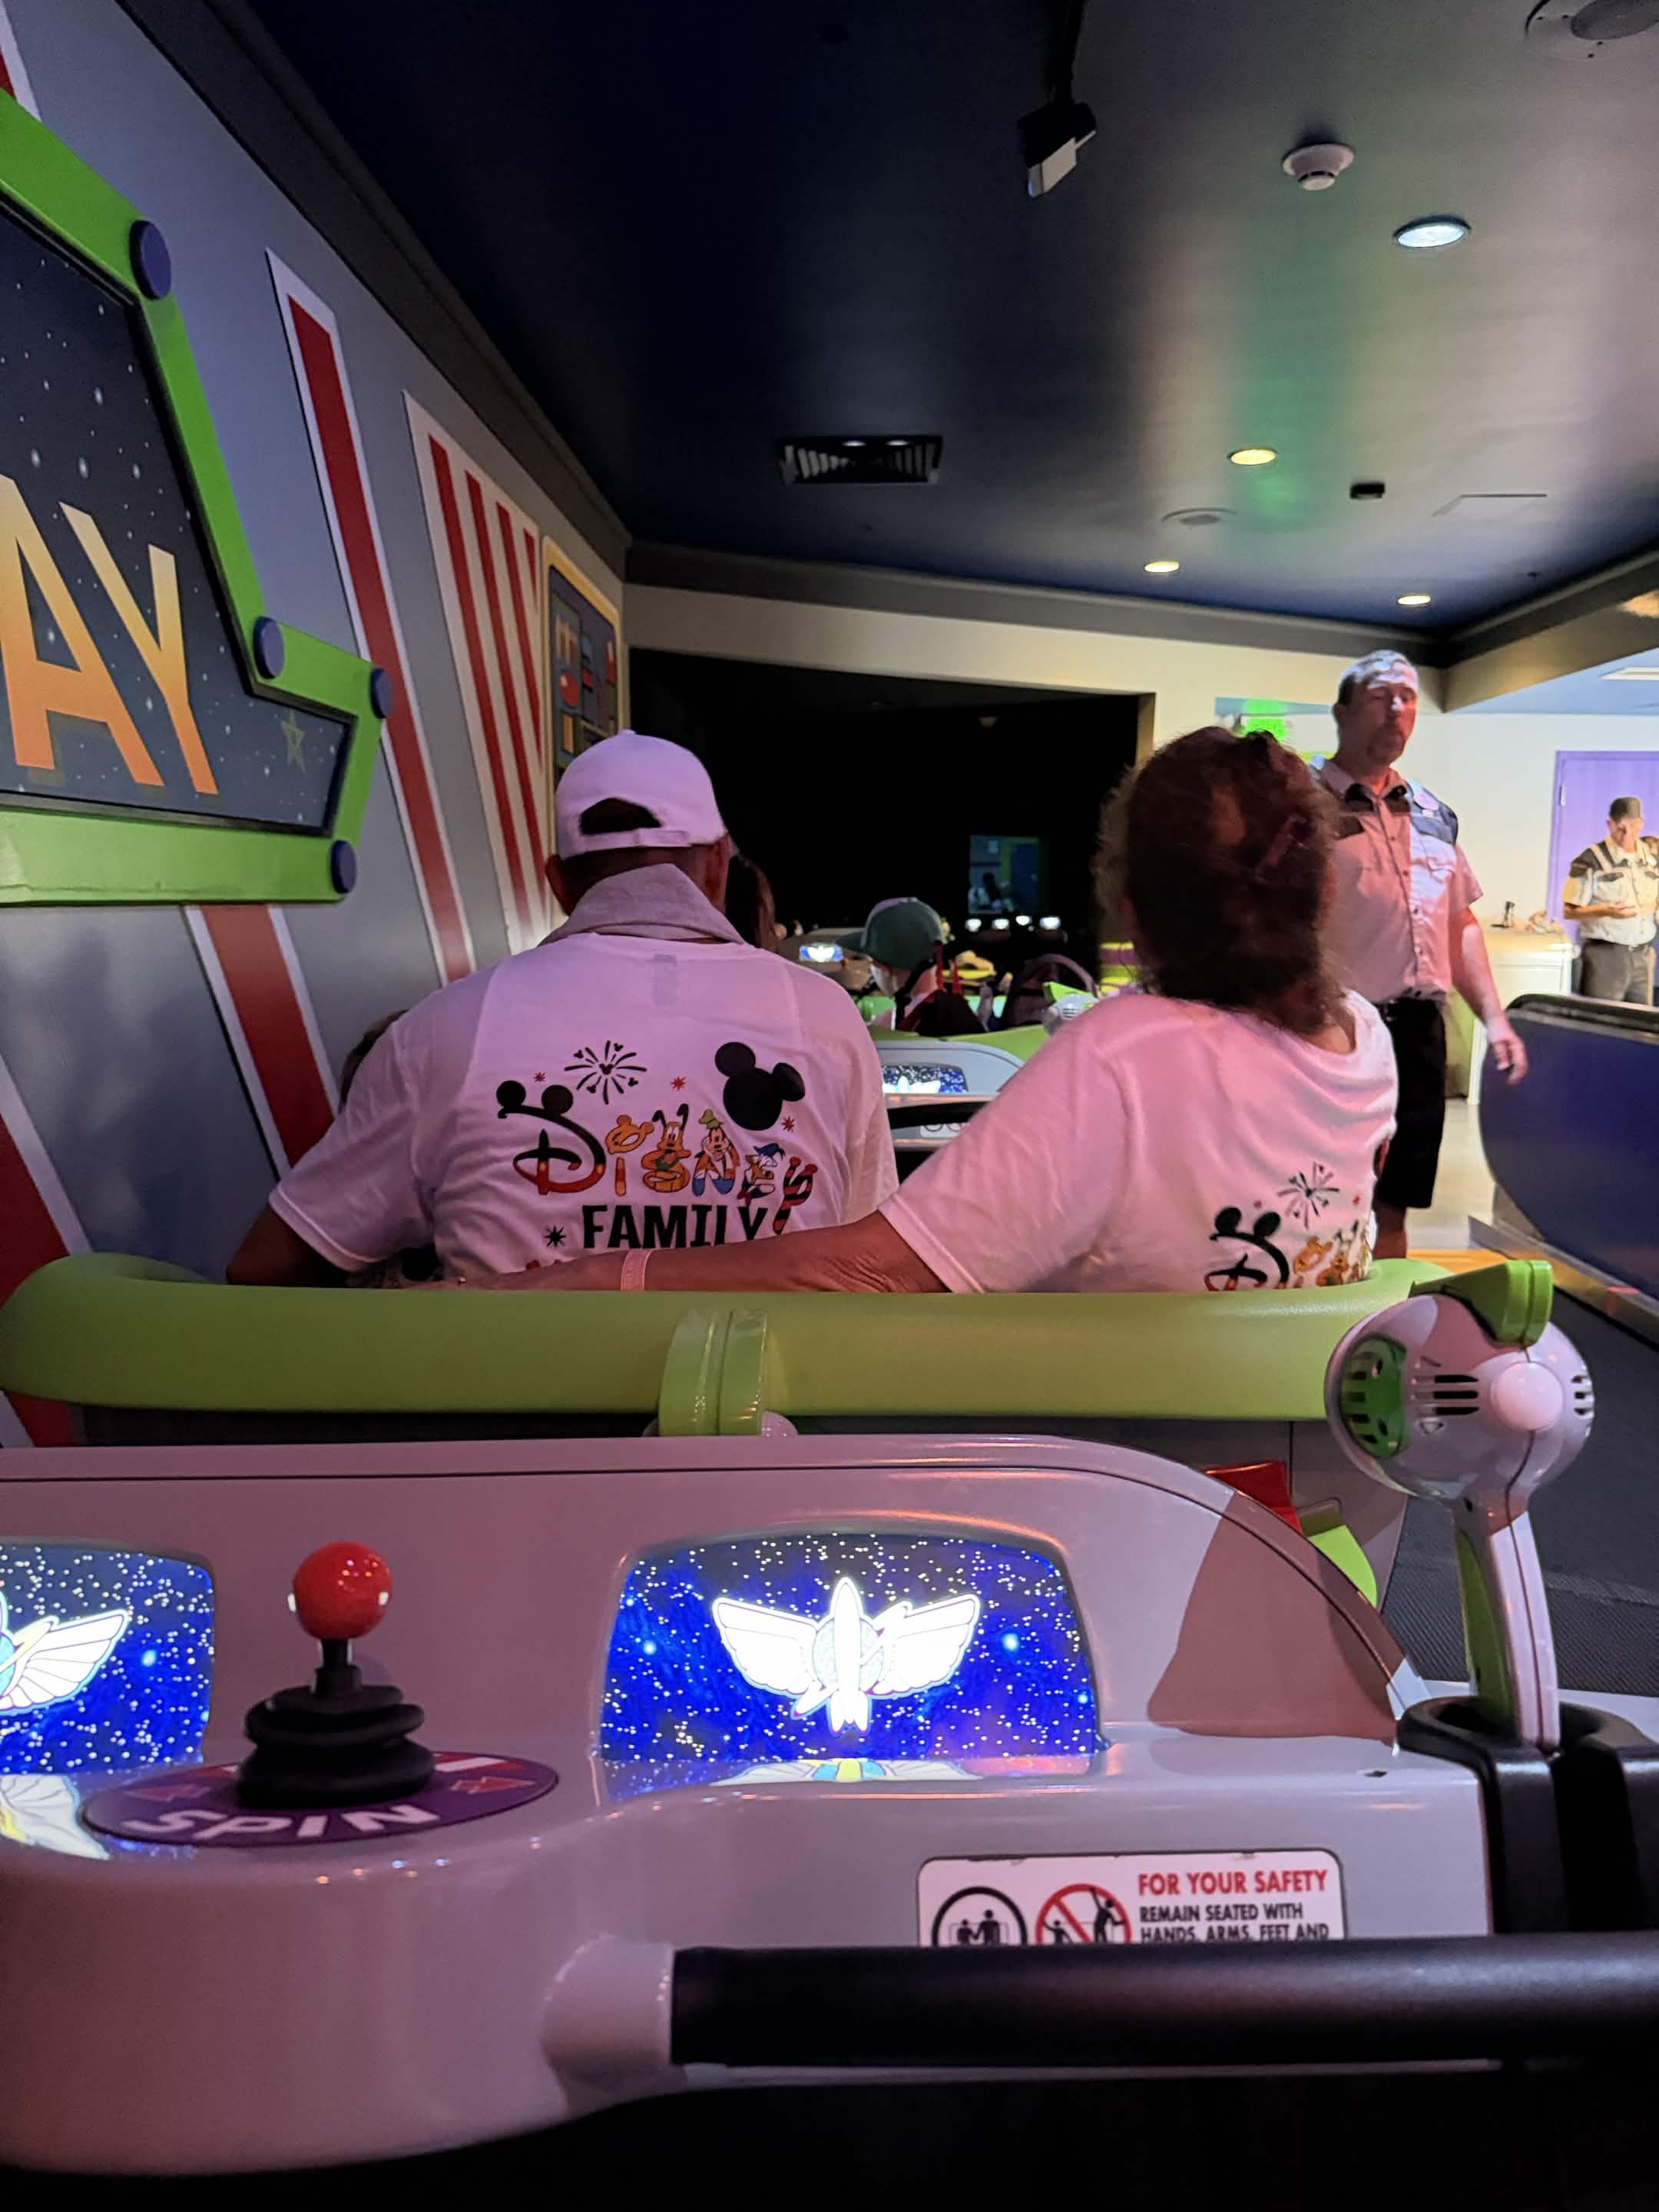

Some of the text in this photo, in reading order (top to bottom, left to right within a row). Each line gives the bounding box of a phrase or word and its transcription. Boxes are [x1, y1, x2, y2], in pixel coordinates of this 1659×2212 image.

[582, 1204, 769, 1249] FAMILY
[121, 1804, 442, 1840] SPIN
[1137, 1869, 1328, 1896] FOR YOUR SAFETY
[1139, 1902, 1303, 1922] REMAIN SEATED WITH
[1205, 1925, 1253, 1941] ARMS
[1260, 1923, 1290, 1941] FEET
[1295, 1922, 1330, 1941] AND
